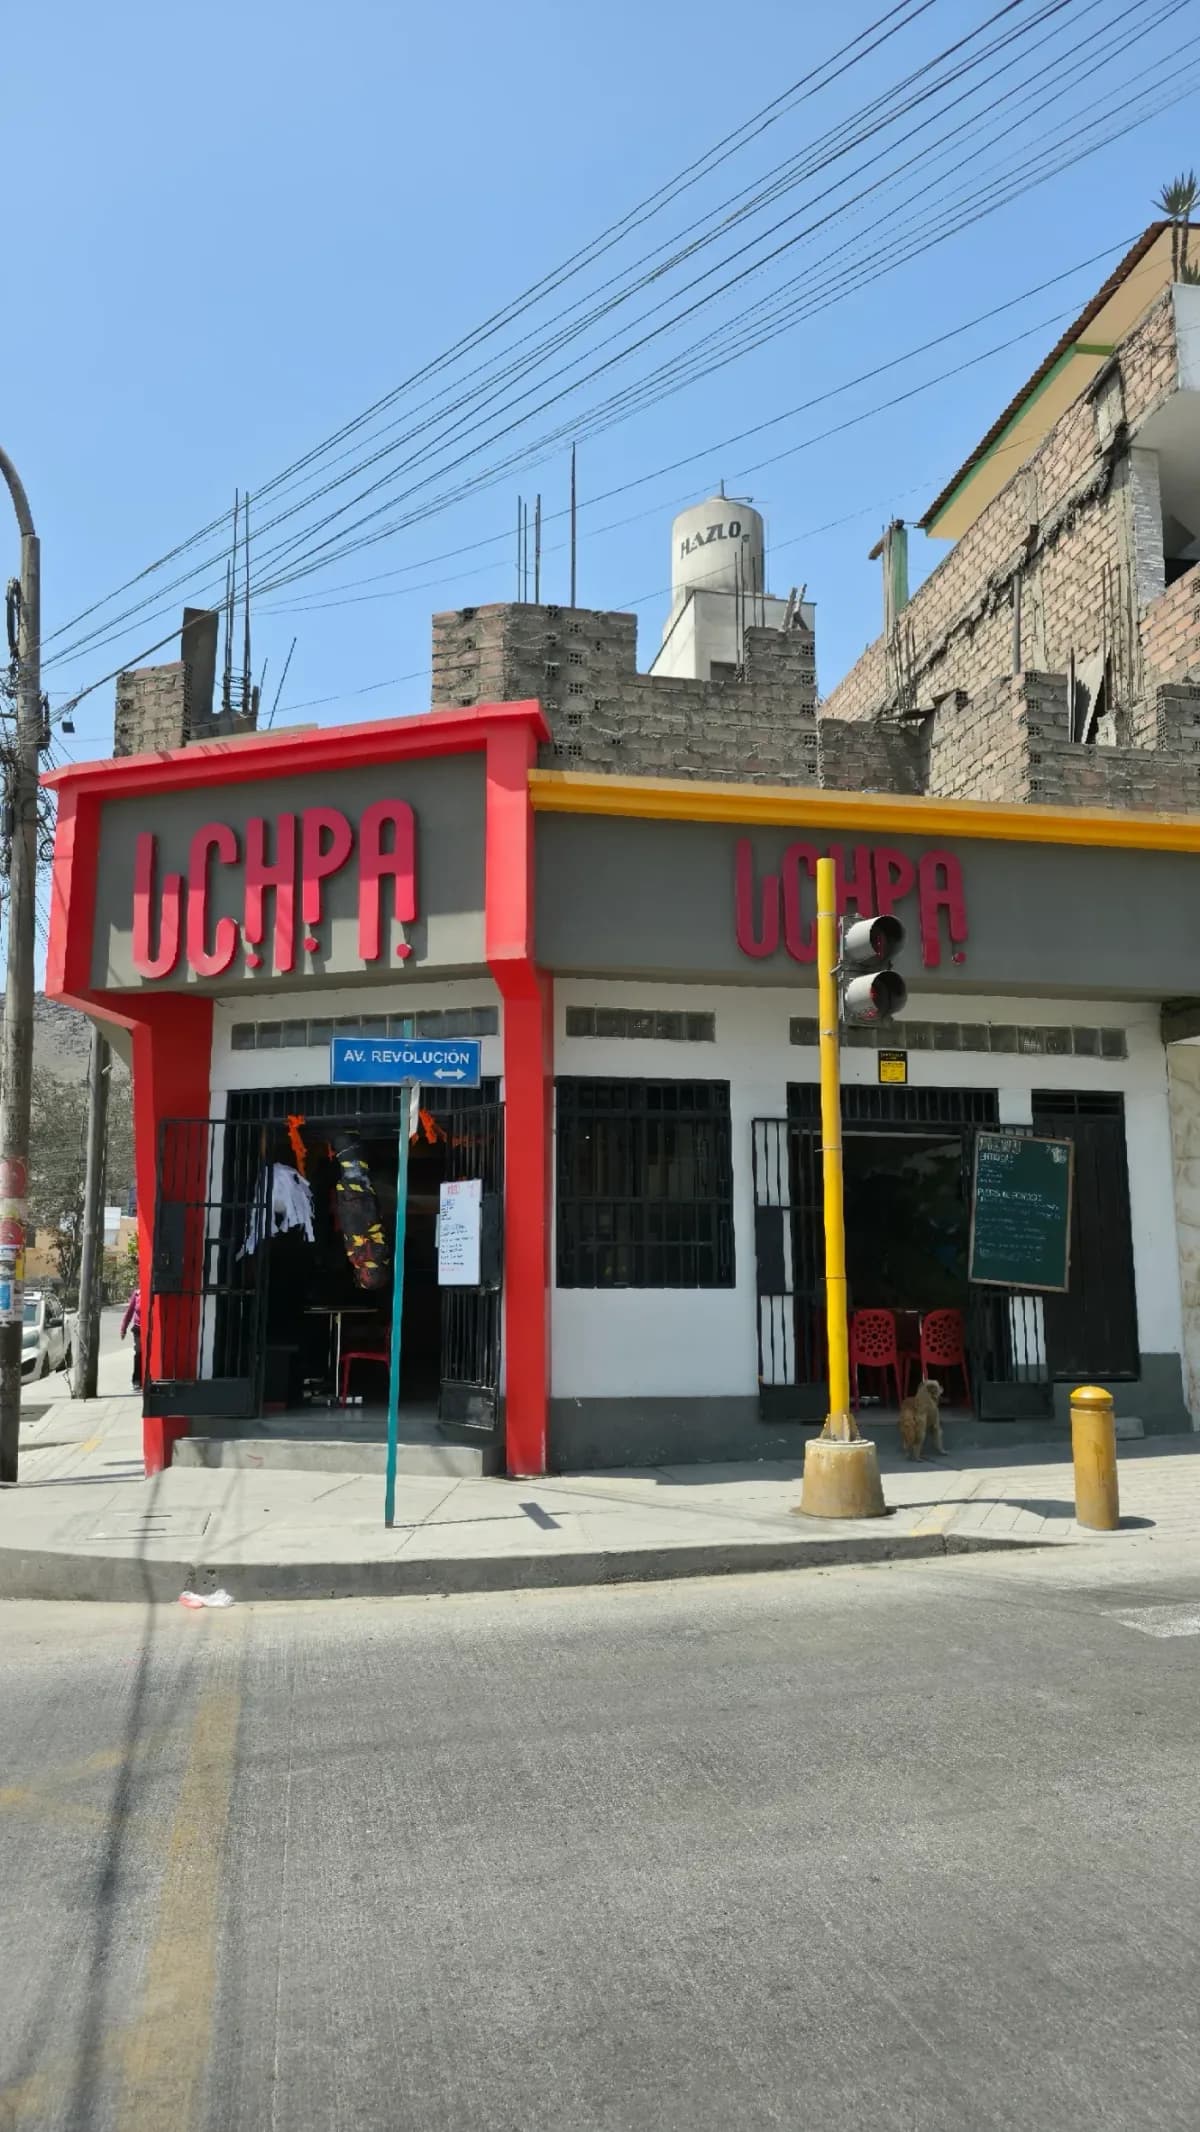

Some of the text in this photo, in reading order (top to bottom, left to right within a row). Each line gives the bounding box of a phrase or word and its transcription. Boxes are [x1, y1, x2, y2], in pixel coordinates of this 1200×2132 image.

[680, 521, 741, 560] HAZLO
[132, 799, 418, 979] UCHPA
[736, 837, 968, 968] UCHPA
[343, 1049, 470, 1065] AV. REVOLUCIÓN
